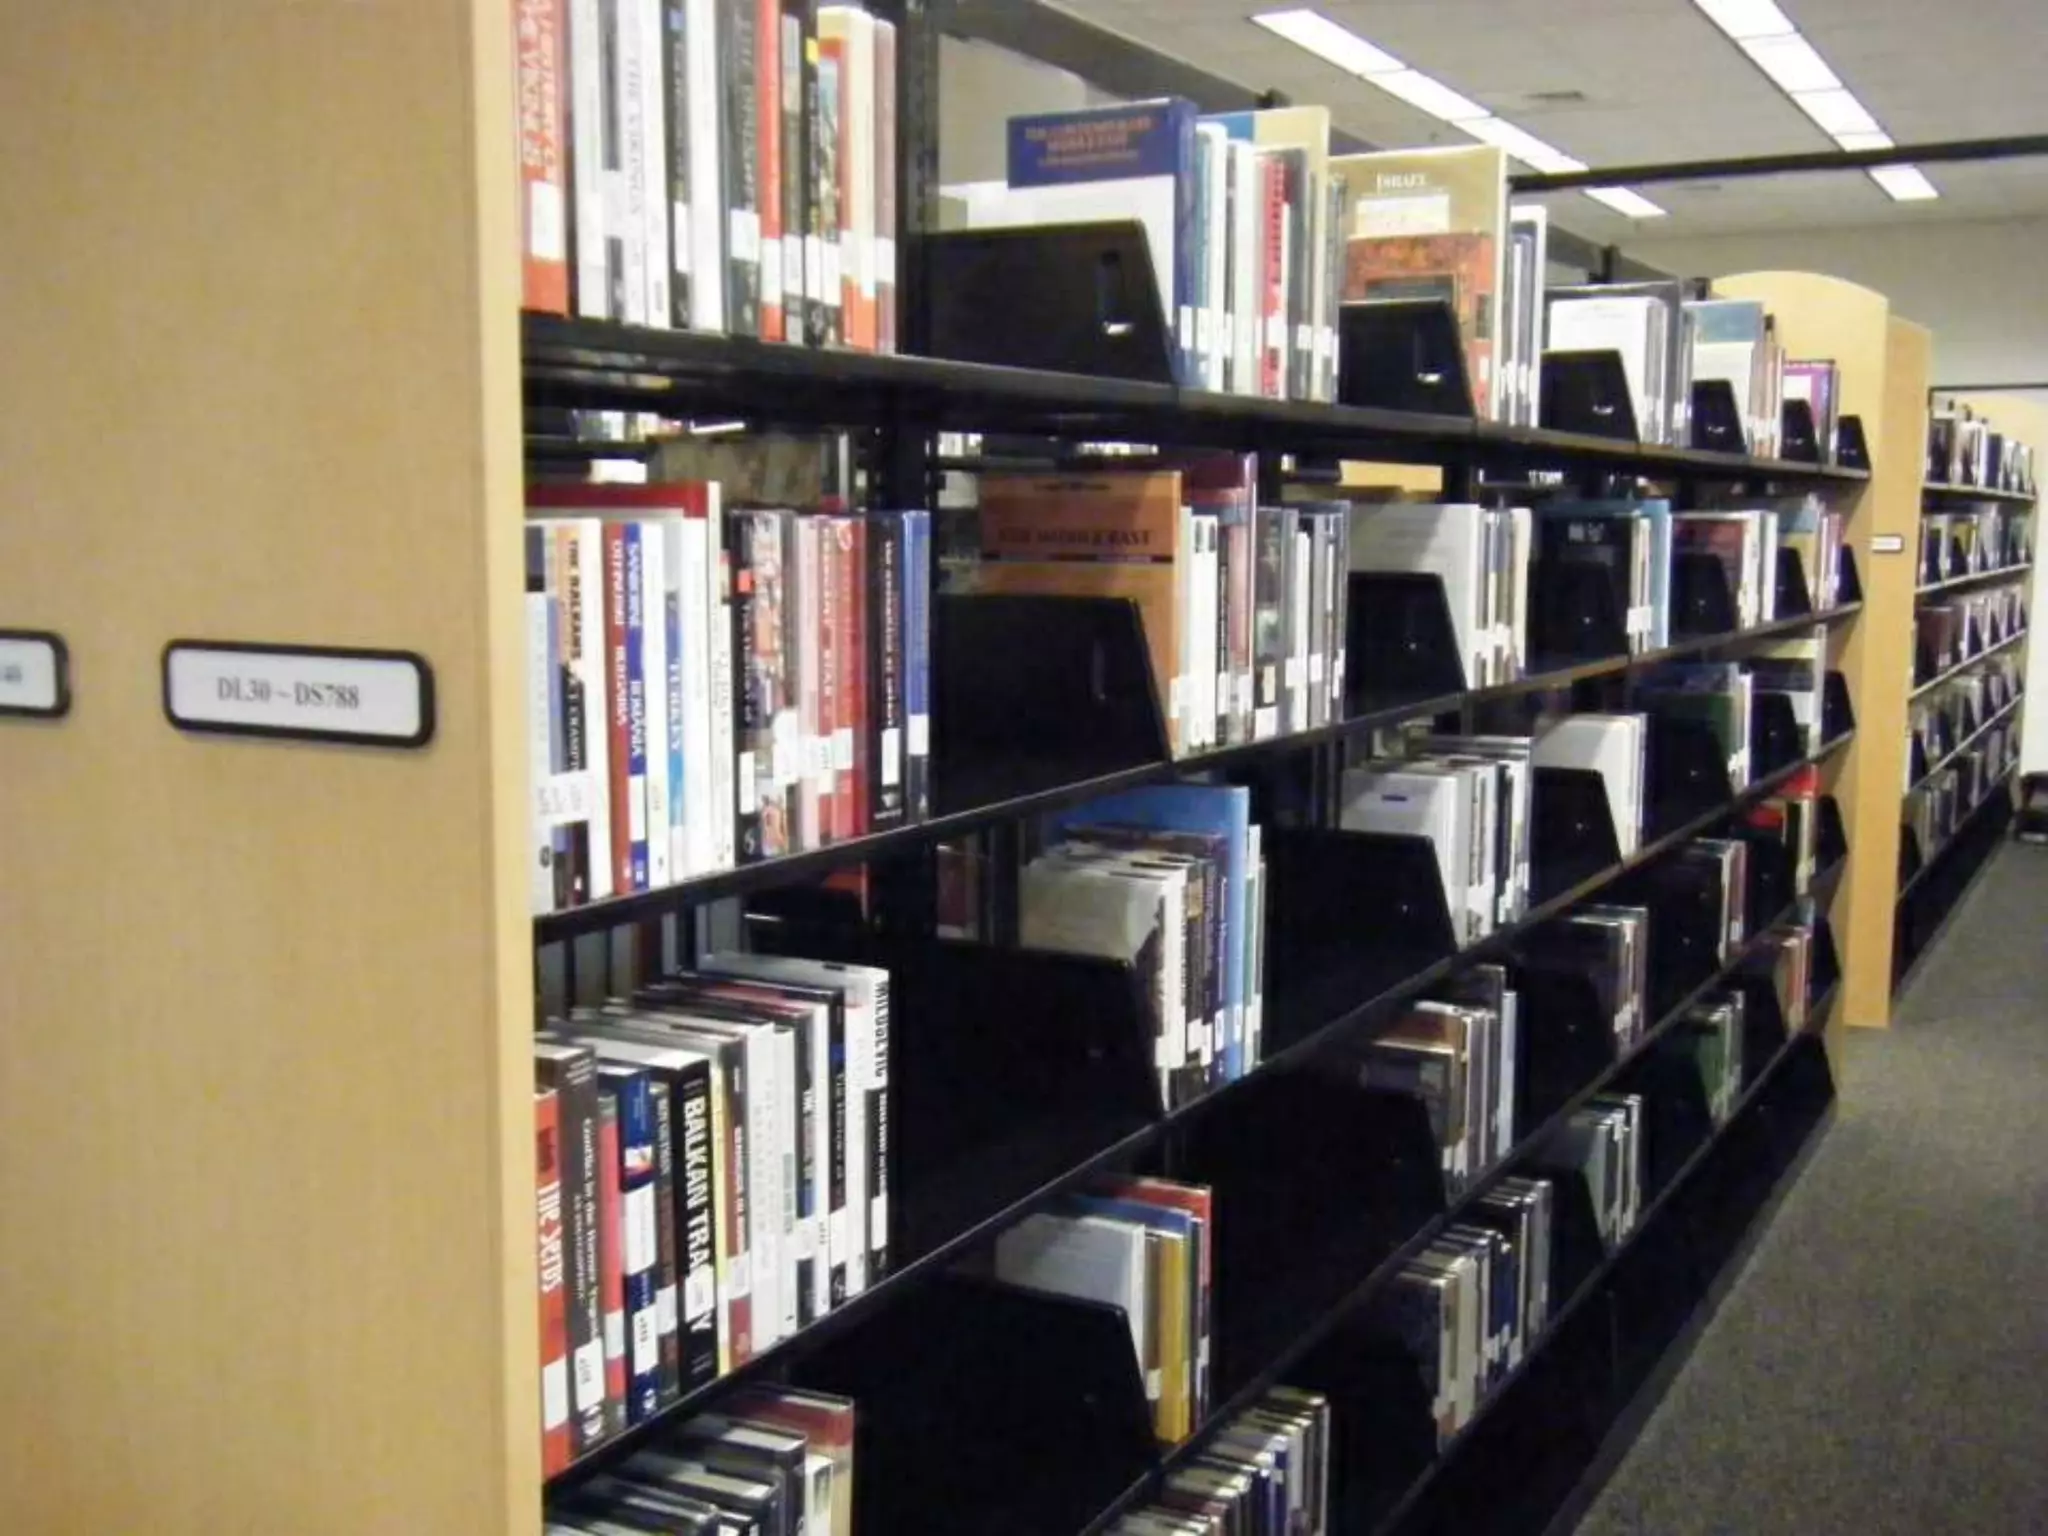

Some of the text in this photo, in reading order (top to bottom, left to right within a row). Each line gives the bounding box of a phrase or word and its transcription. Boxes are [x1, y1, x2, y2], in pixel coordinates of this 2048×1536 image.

[295, 682, 360, 710] DS788
[629, 679, 644, 758] ROMANIA
[538, 1182, 560, 1226] The
[683, 1098, 713, 1334] BALKAN TRAY
[541, 1232, 564, 1293] Serbs
